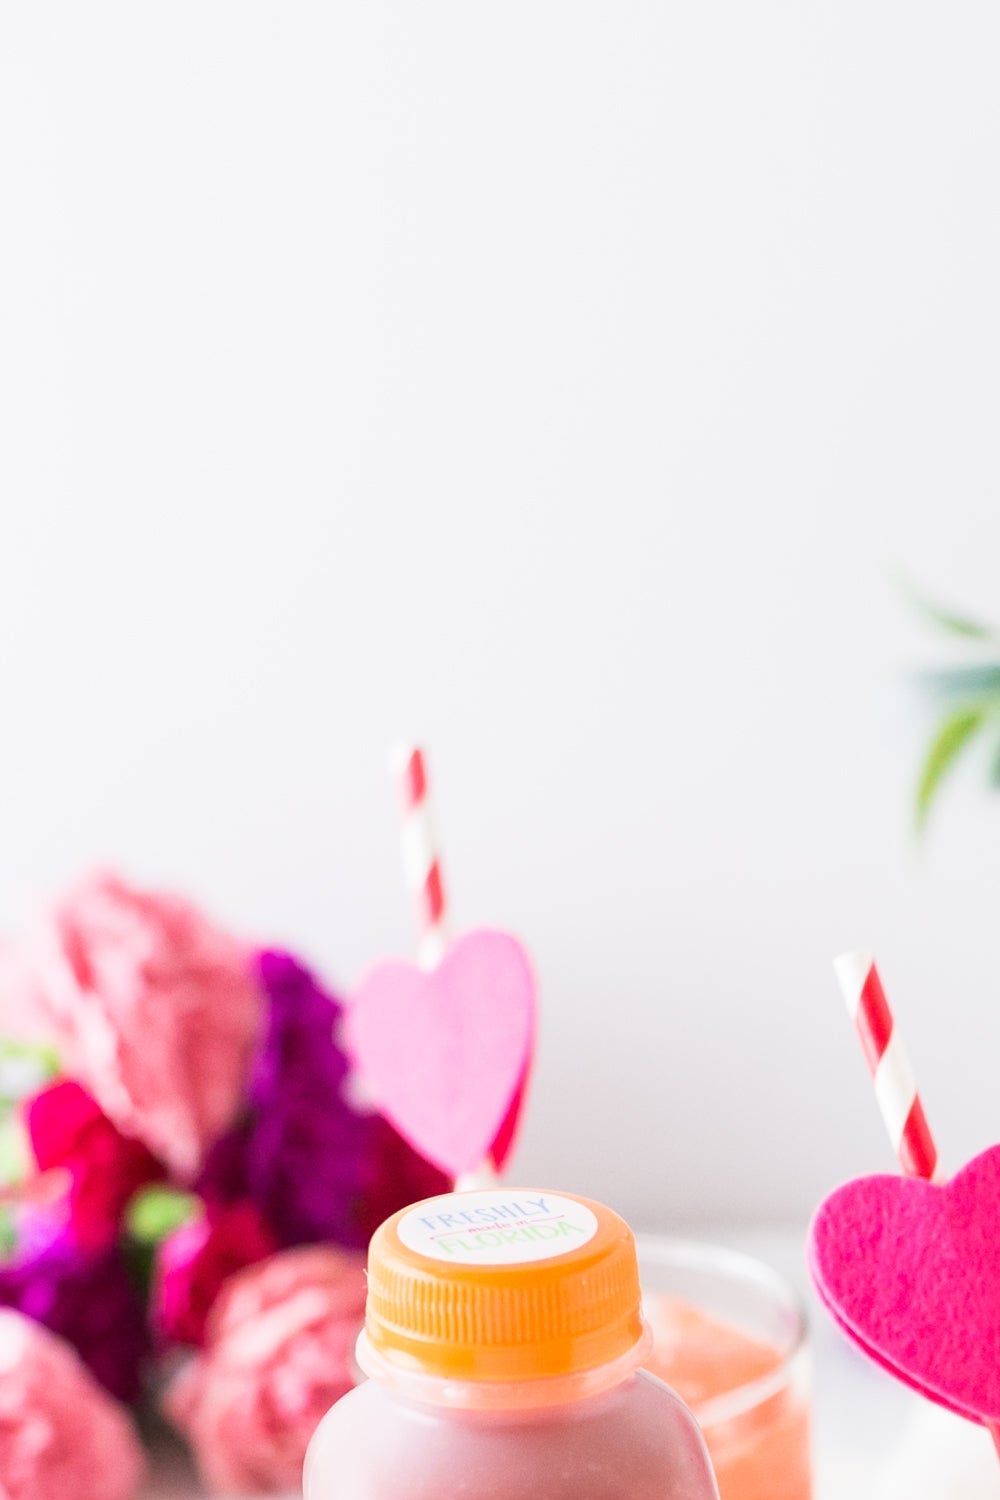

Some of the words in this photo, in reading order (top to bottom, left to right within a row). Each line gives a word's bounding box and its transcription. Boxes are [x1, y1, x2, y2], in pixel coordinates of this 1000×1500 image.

[420, 1198, 553, 1230] FRESHLY
[468, 1222, 512, 1233] made
[437, 1220, 587, 1254] FLORIDA
